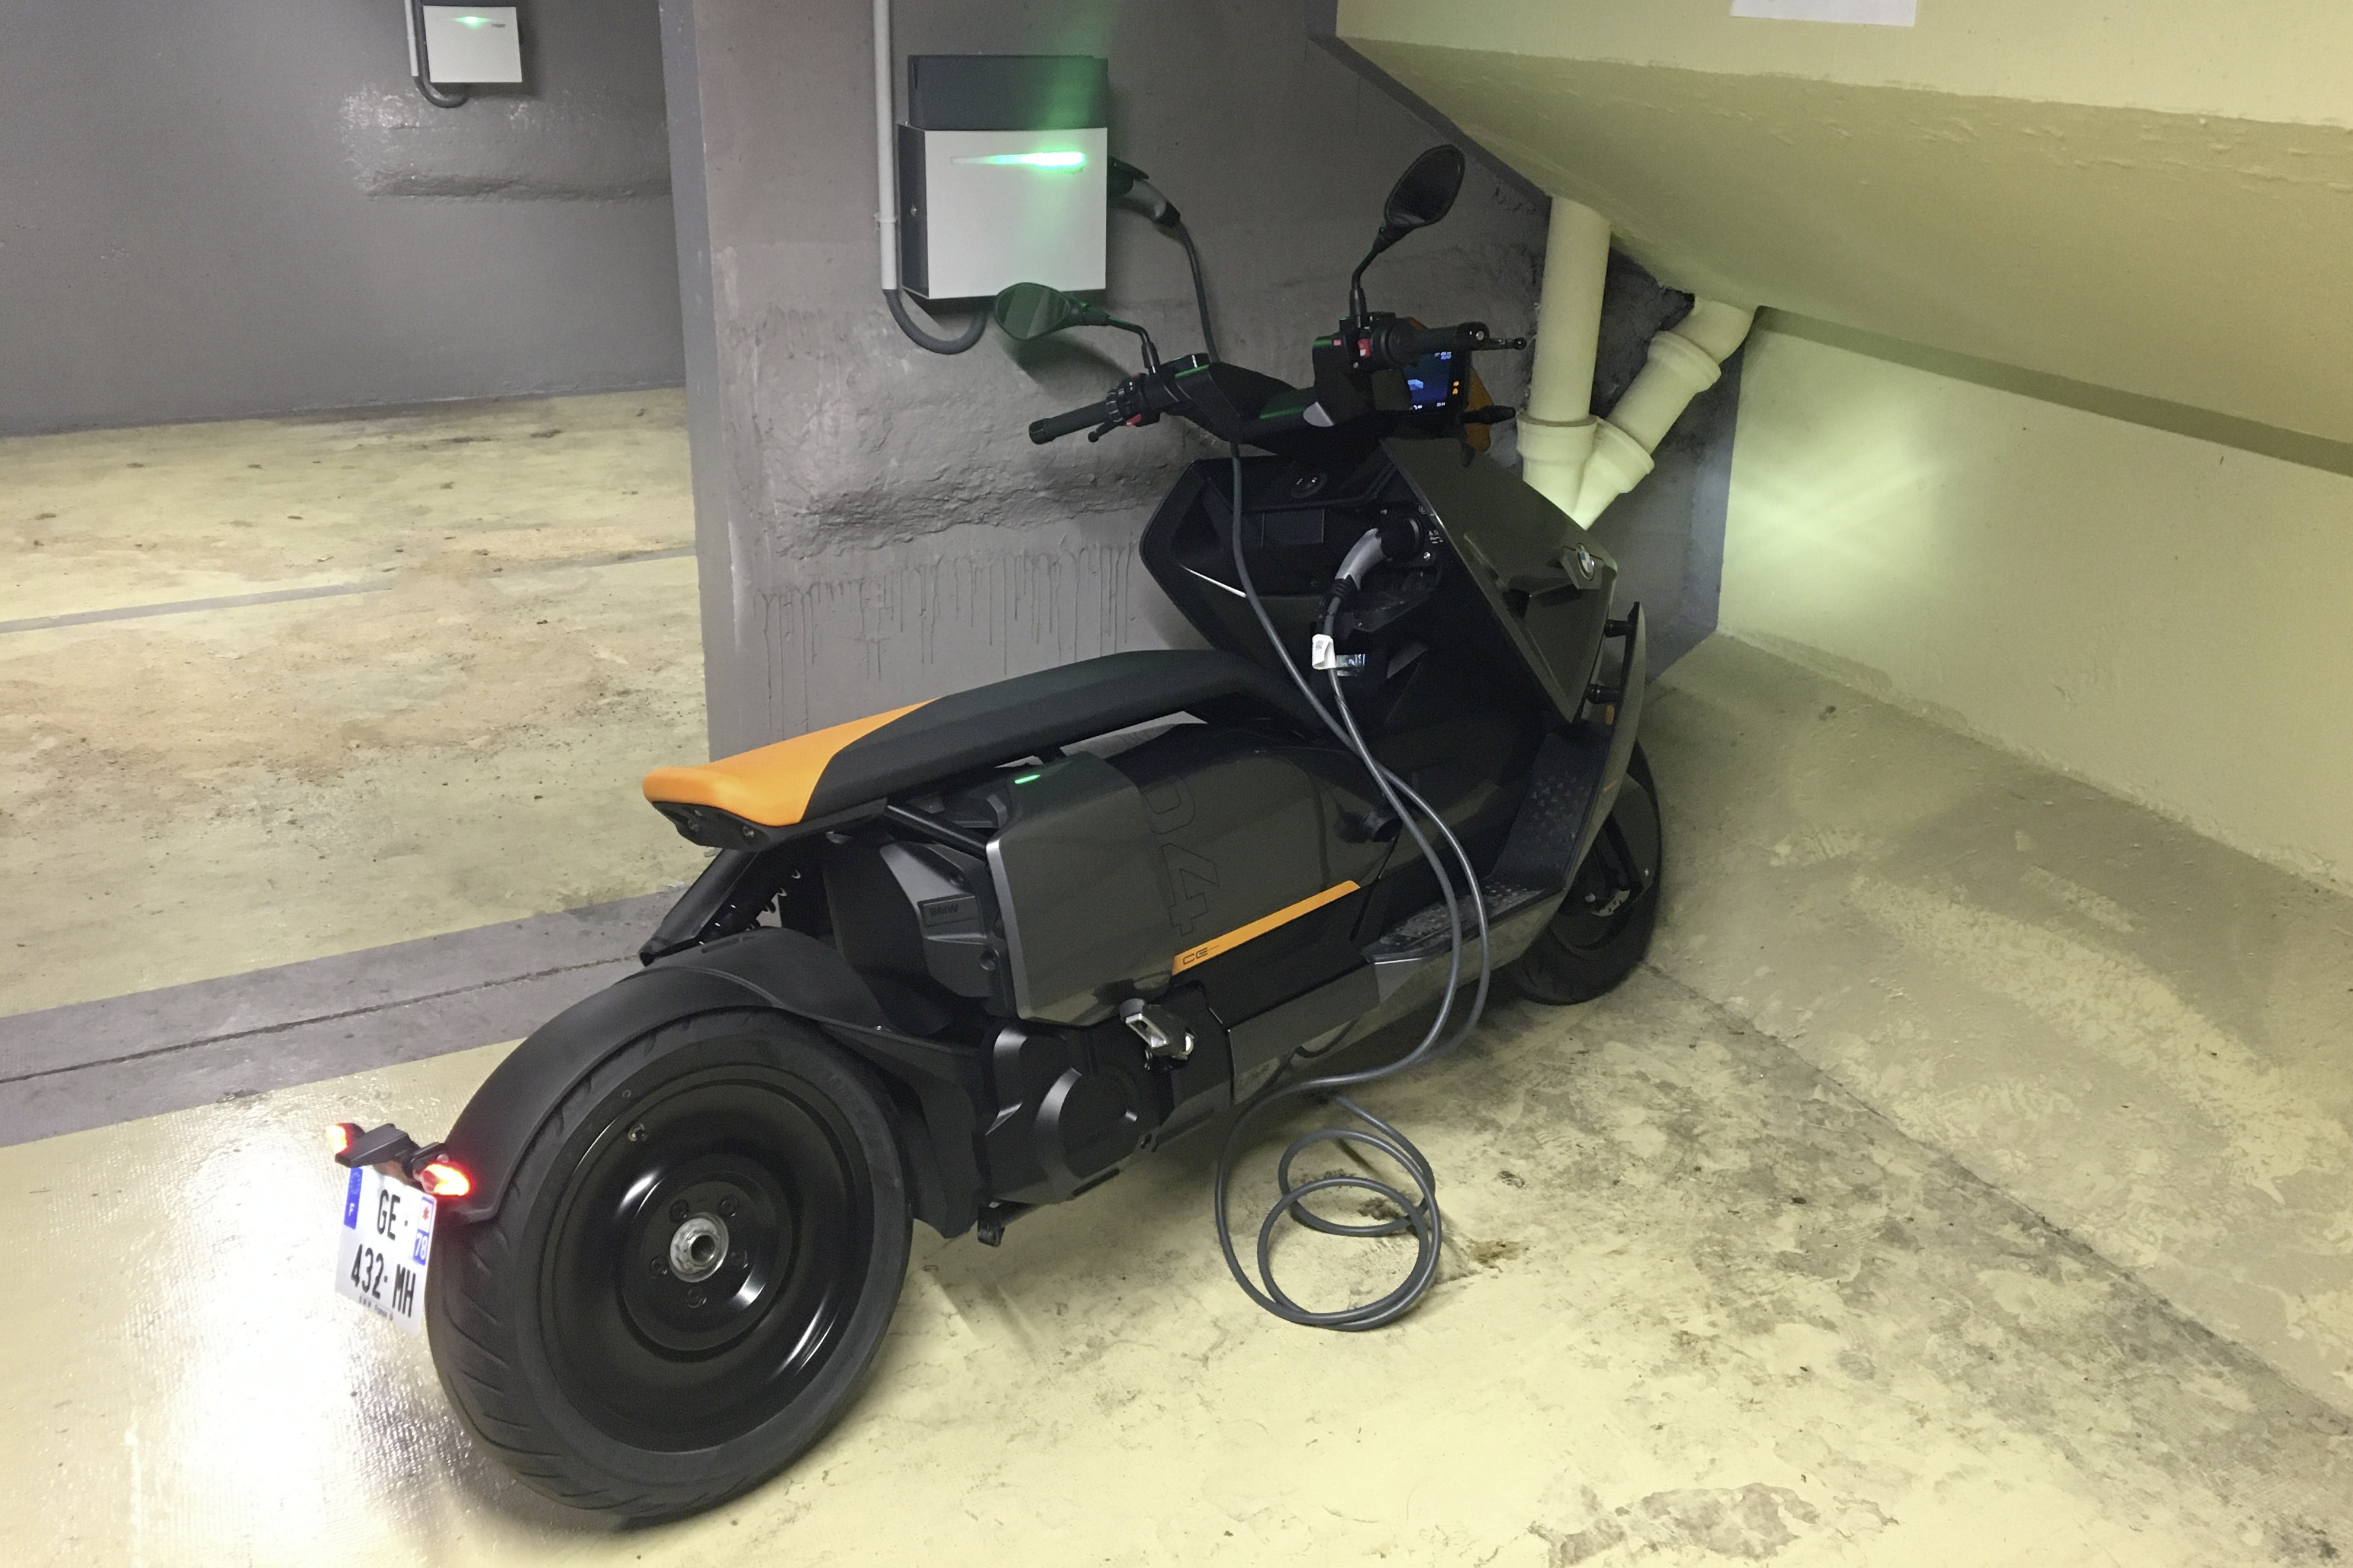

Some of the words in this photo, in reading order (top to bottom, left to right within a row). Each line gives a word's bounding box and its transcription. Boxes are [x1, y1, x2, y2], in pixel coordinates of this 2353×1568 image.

[929, 903, 960, 916] BMW
[349, 1202, 355, 1216] F
[415, 1232, 429, 1260] 78
